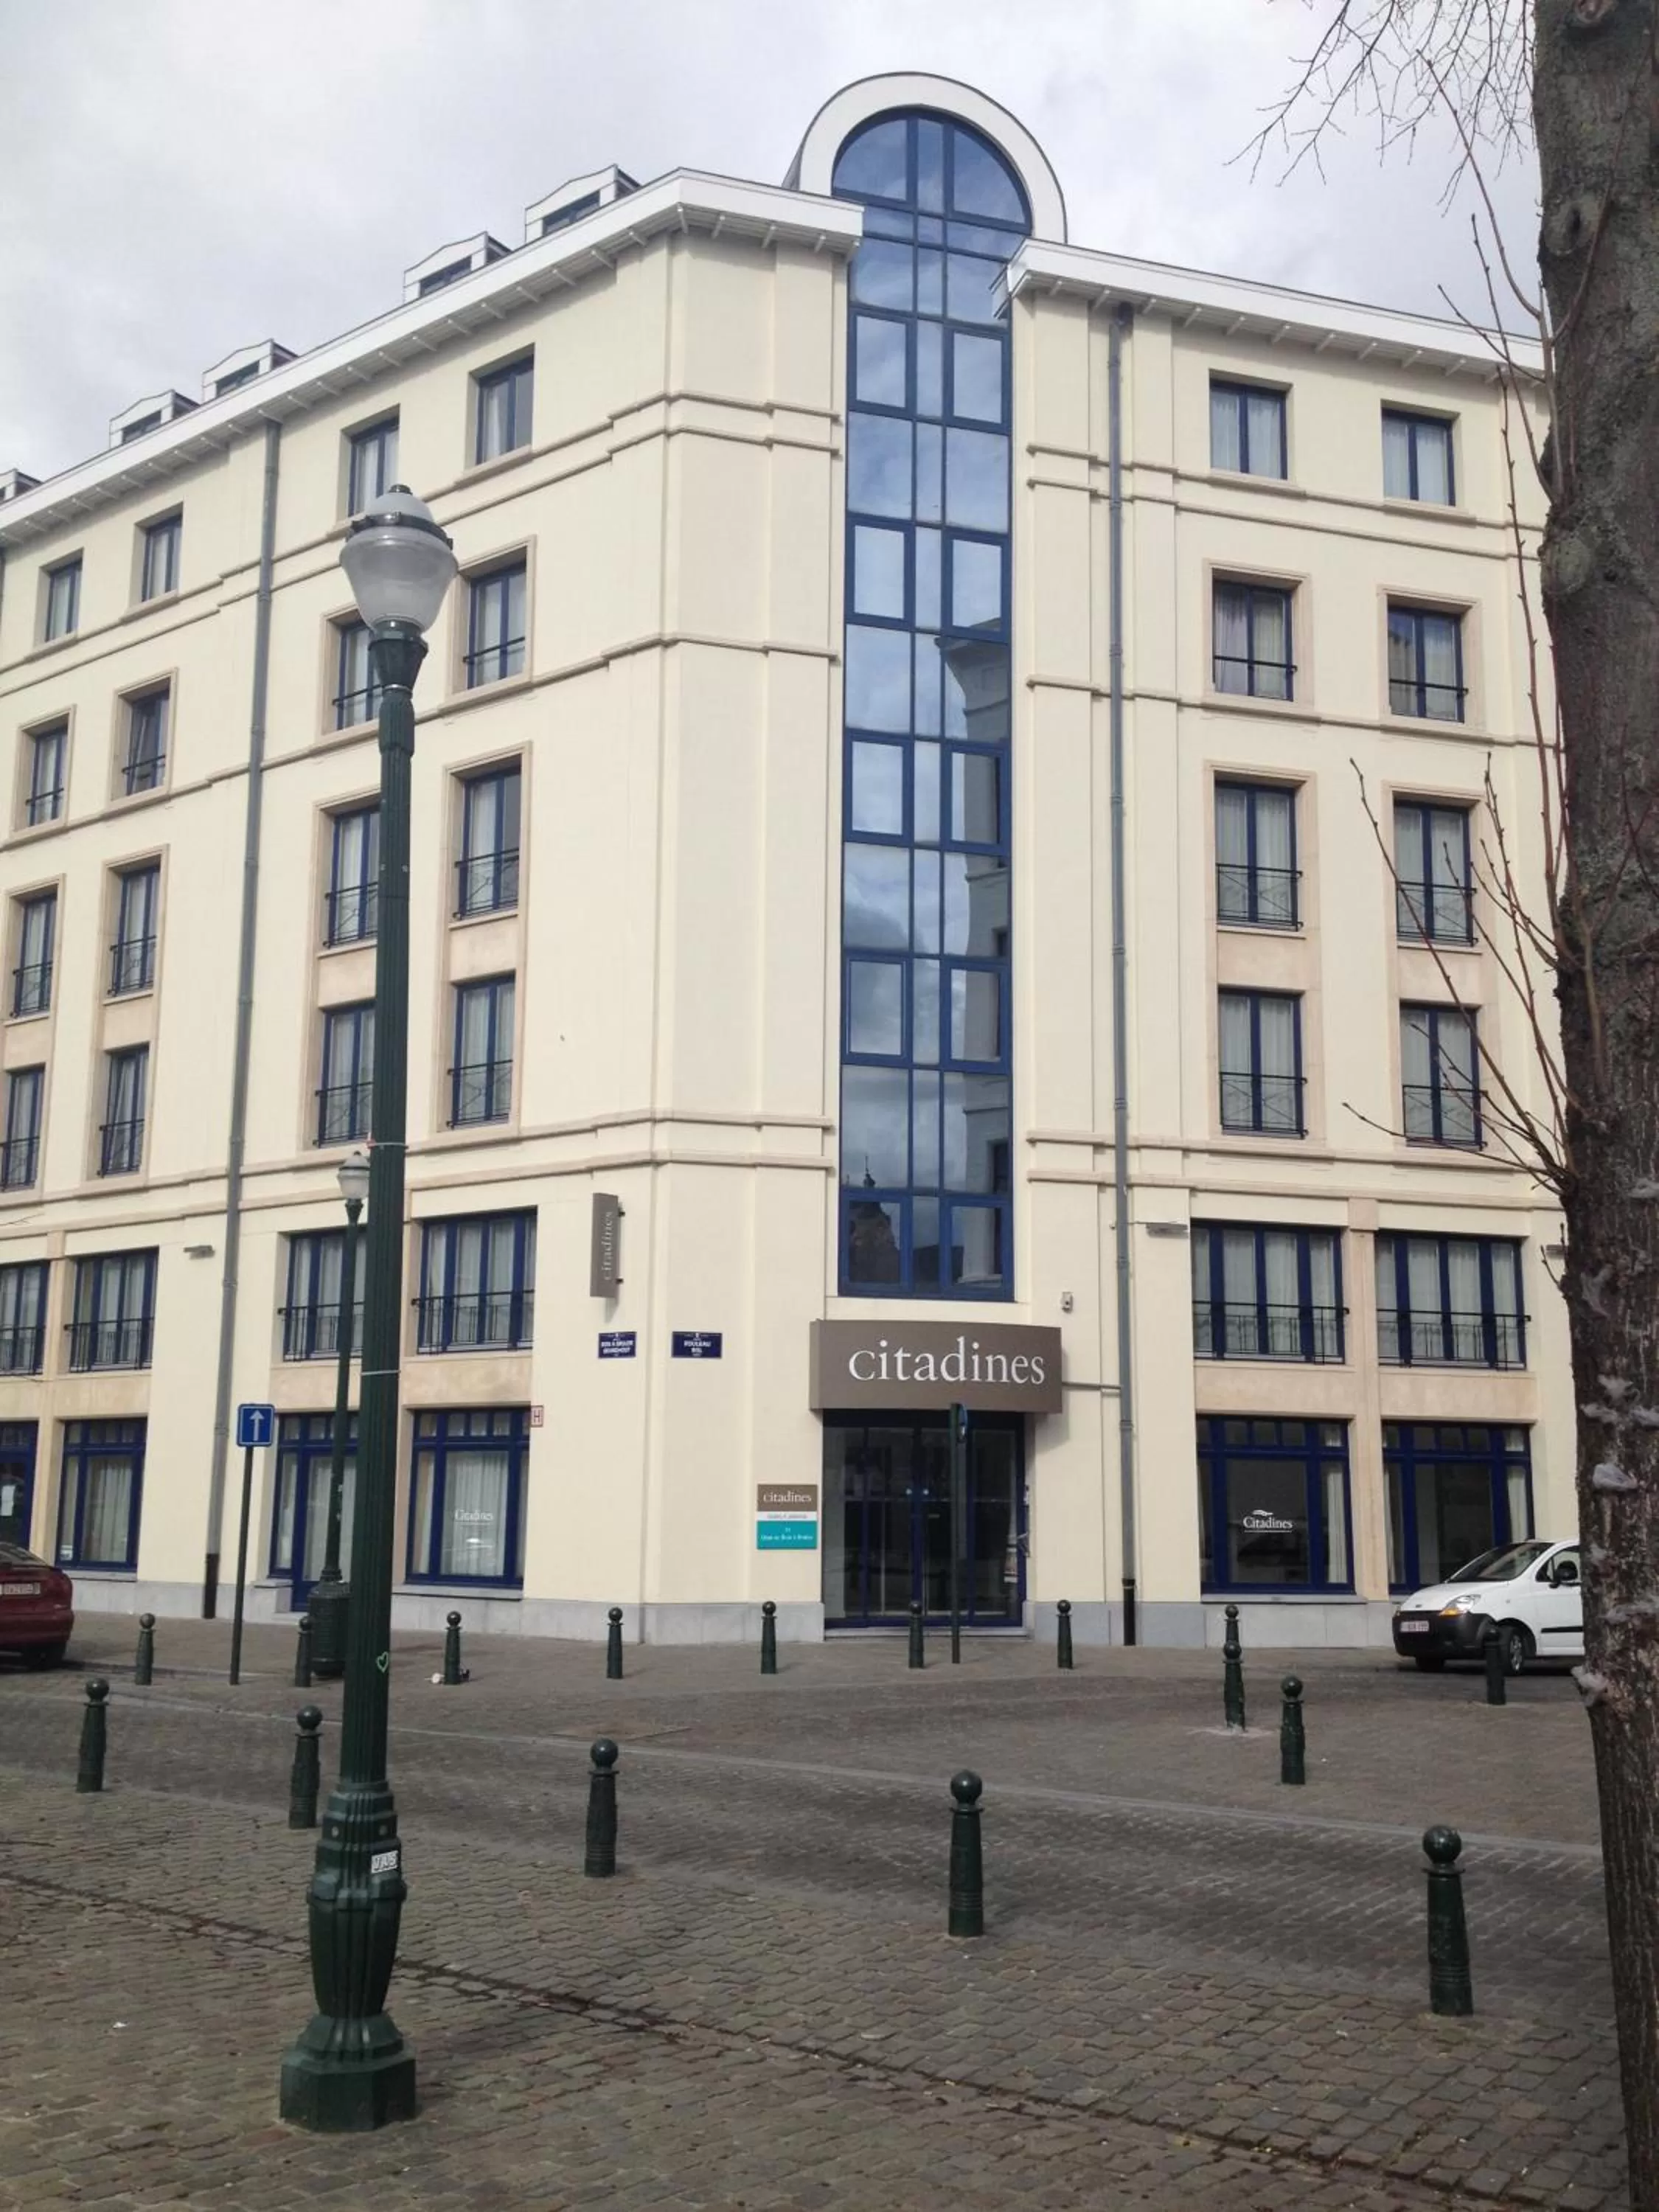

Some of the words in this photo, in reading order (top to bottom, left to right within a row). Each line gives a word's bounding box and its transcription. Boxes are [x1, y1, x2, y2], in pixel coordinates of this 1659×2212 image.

[601, 1211, 613, 1281] citadines
[849, 1335, 1045, 1385] citadines
[762, 1490, 812, 1502] citadines
[1243, 1516, 1293, 1528] Citadines
